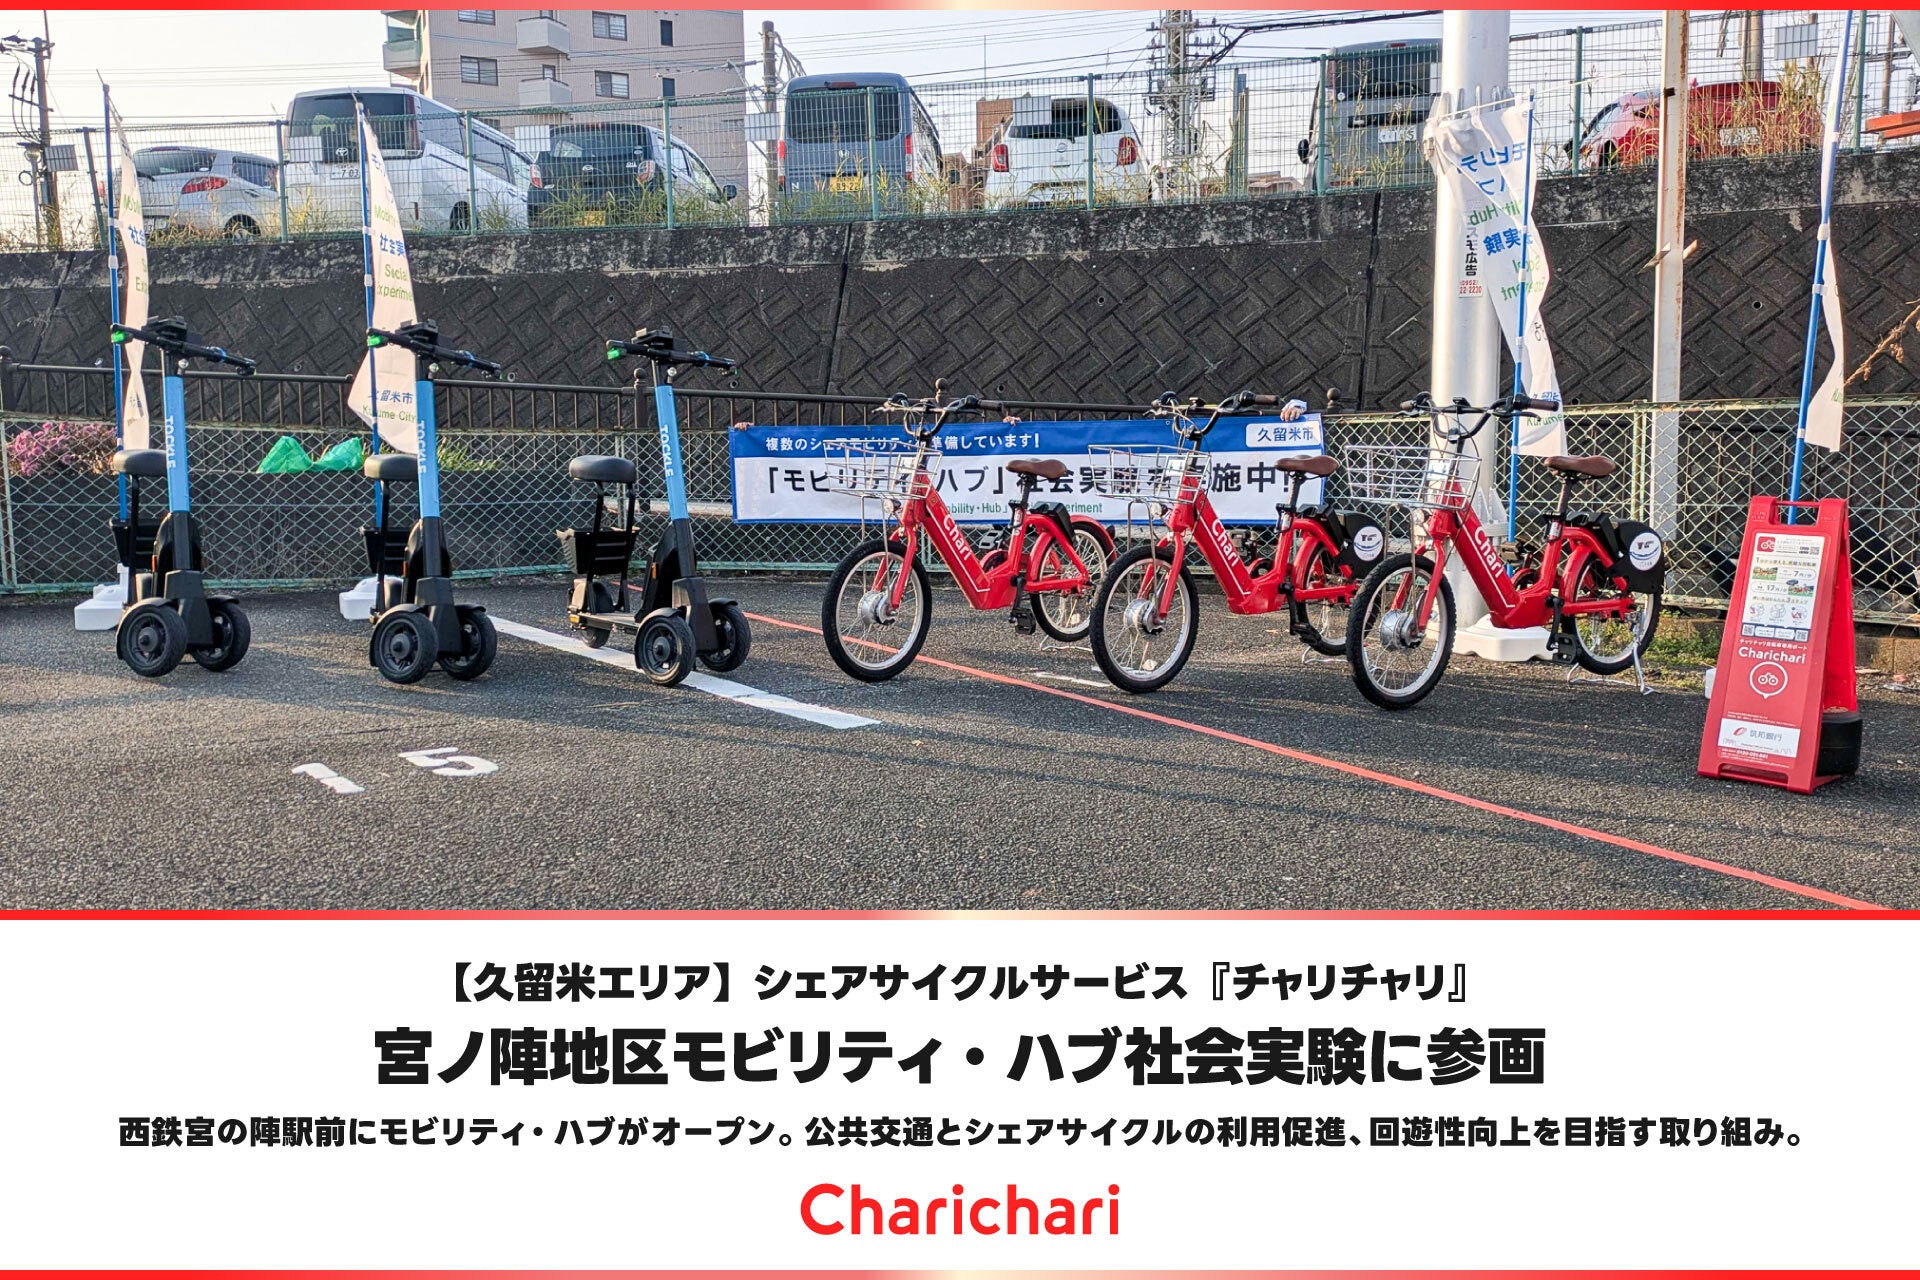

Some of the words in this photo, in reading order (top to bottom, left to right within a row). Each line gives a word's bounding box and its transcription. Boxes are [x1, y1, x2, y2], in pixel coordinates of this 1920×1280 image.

[417, 420, 427, 474] TOCKLE
[660, 424, 674, 478] TOCKLE
[1257, 426, 1314, 442] 久留米市
[943, 513, 973, 561] Chari
[1212, 518, 1241, 567] Chari
[1474, 526, 1504, 578] Chari
[1738, 646, 1806, 664] Charichari
